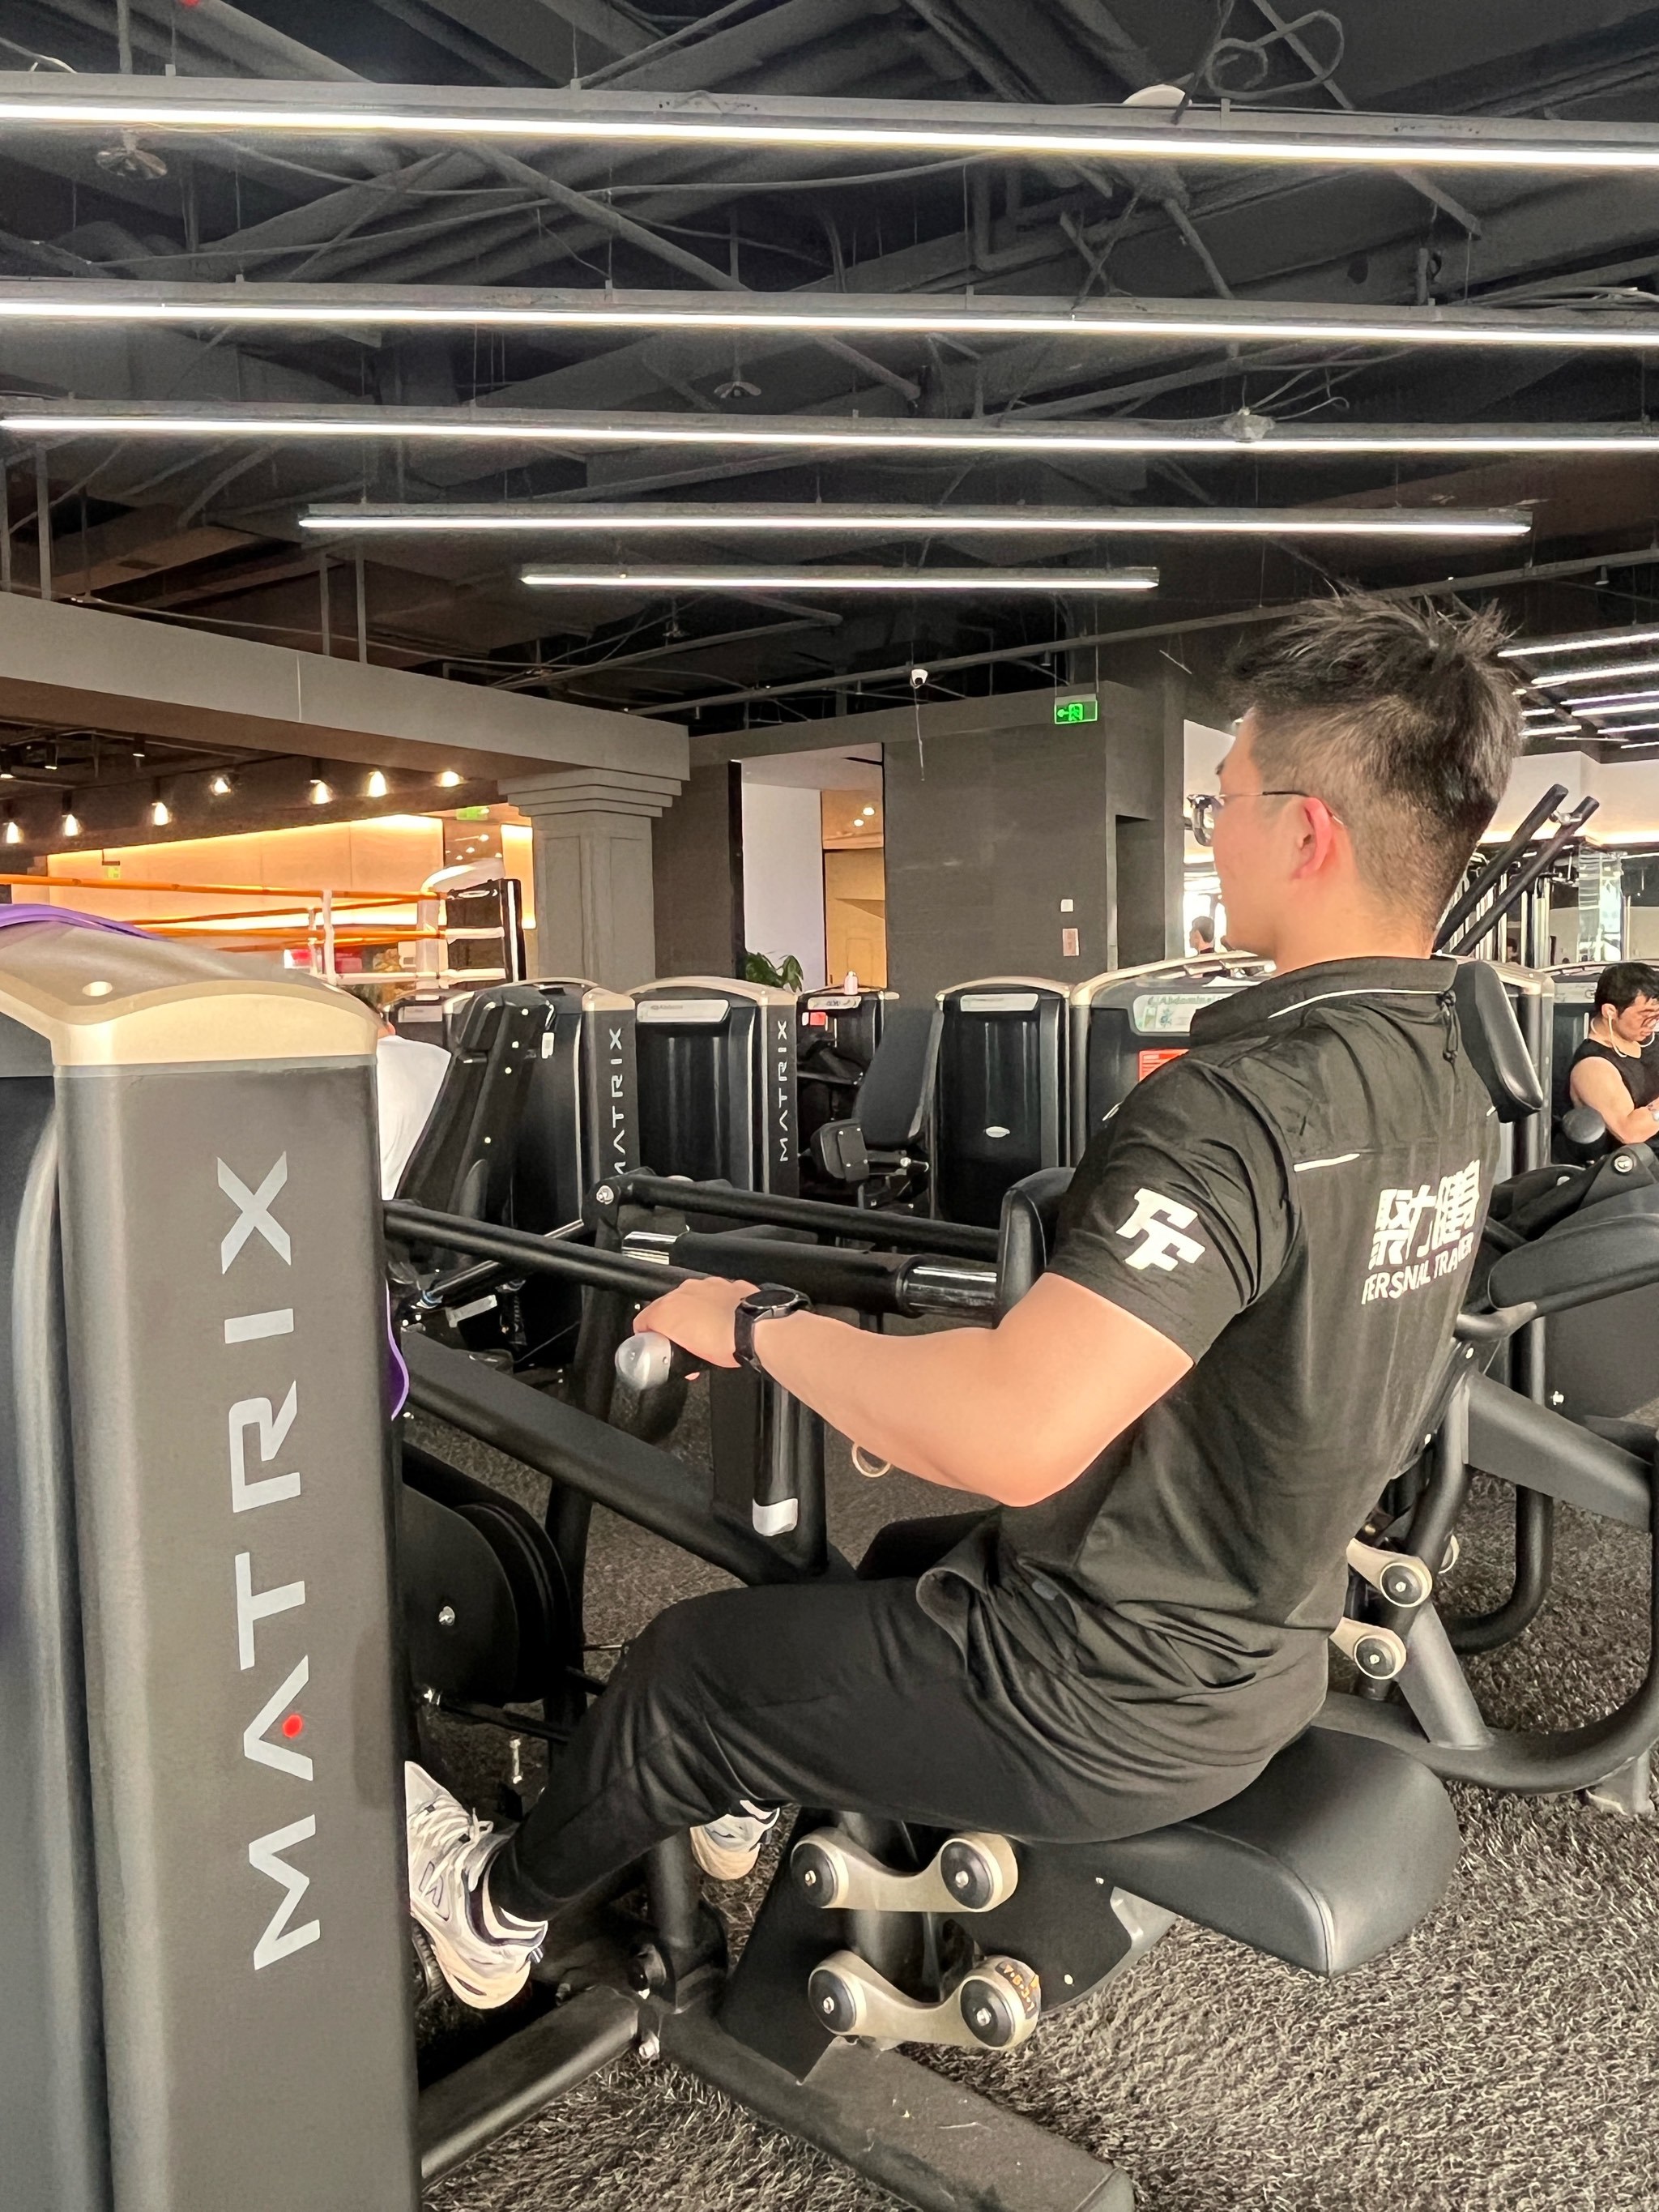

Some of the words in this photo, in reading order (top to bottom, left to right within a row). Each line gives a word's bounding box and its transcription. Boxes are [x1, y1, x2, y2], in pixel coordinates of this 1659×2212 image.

[778, 1020, 788, 1162] MATRIX
[1361, 1260, 1431, 1305] PERSNAL
[216, 1151, 321, 1970] MATRIX
